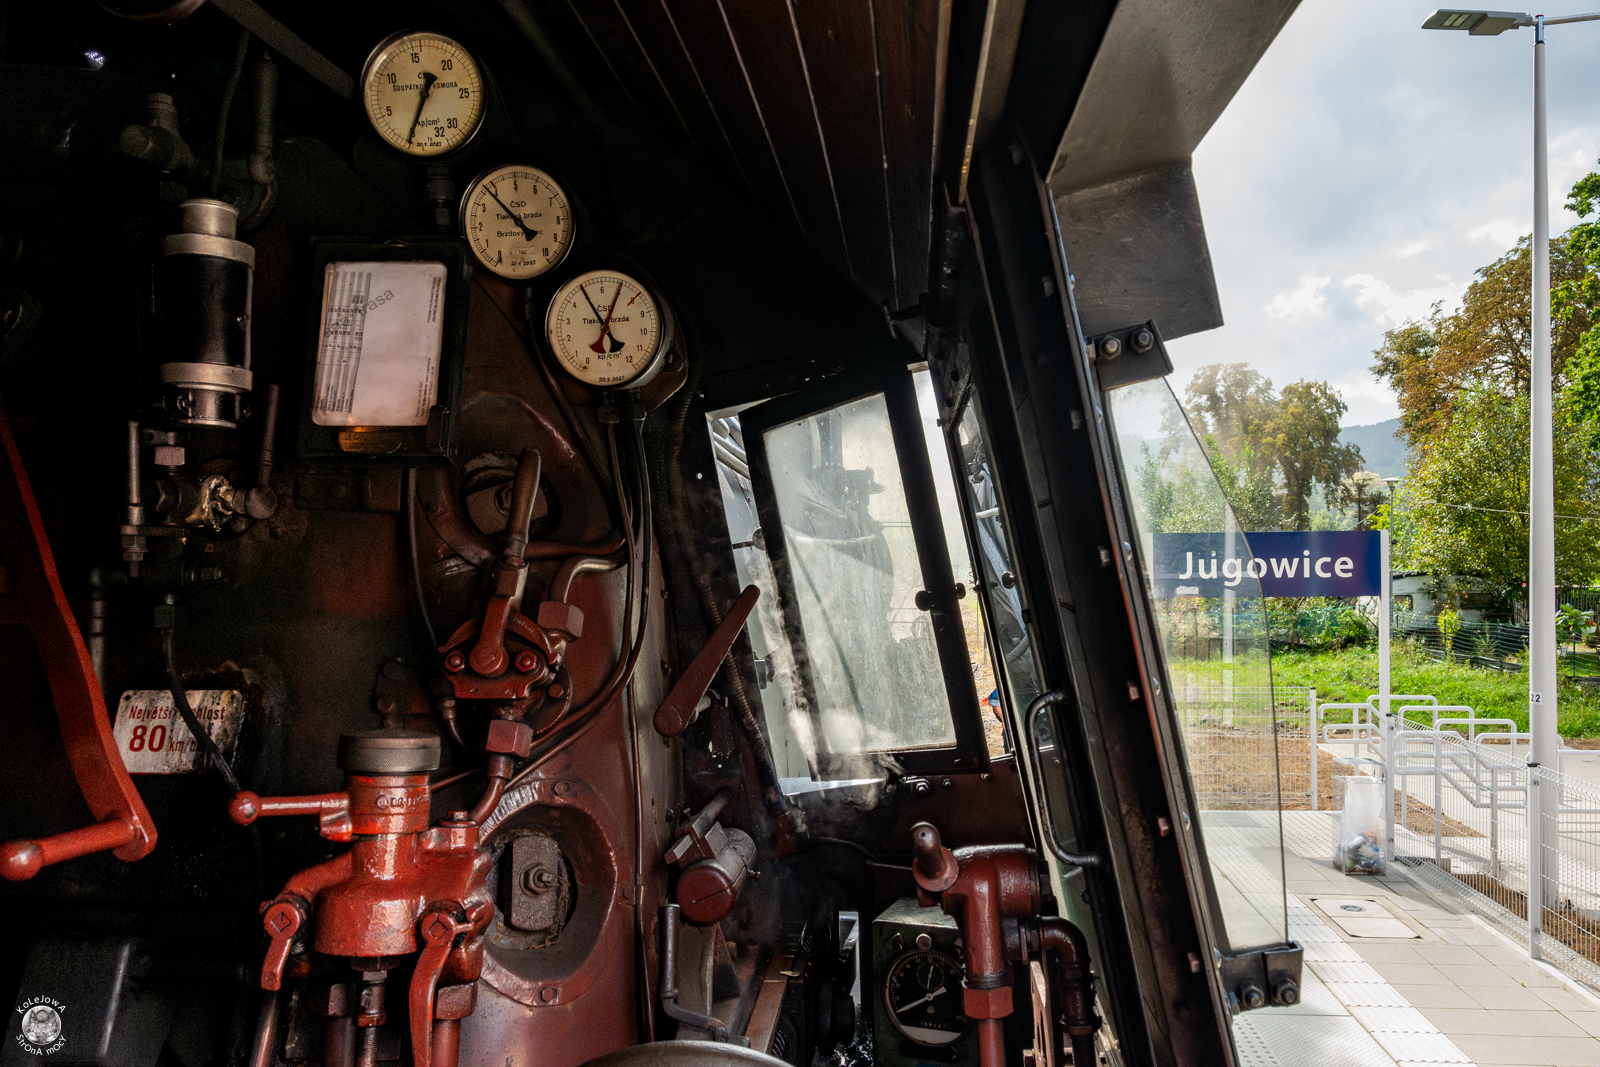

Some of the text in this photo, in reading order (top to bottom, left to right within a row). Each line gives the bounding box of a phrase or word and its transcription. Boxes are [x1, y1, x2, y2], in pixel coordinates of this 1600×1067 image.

[410, 53, 420, 63] 15
[441, 59, 453, 71] 20
[387, 72, 397, 84] 10
[433, 81, 458, 90] KOMORA
[458, 88, 470, 99] 25
[386, 106, 392, 117] 5
[446, 118, 458, 129] 30
[434, 126, 445, 138] 32
[513, 180, 518, 191] 5
[533, 185, 538, 194] 6
[510, 200, 527, 209] ČSD
[548, 197, 553, 207] 7
[481, 203, 487, 213] 3
[523, 211, 542, 219] brzda
[556, 215, 561, 225] 8
[478, 222, 483, 232] 2
[553, 233, 558, 243] 9
[485, 239, 489, 248] 1
[541, 247, 550, 257] 10
[626, 355, 633, 363] 12
[1178, 549, 1354, 587] Jugowice
[1530, 693, 1541, 702] 22
[129, 724, 197, 753] 80 km/h
